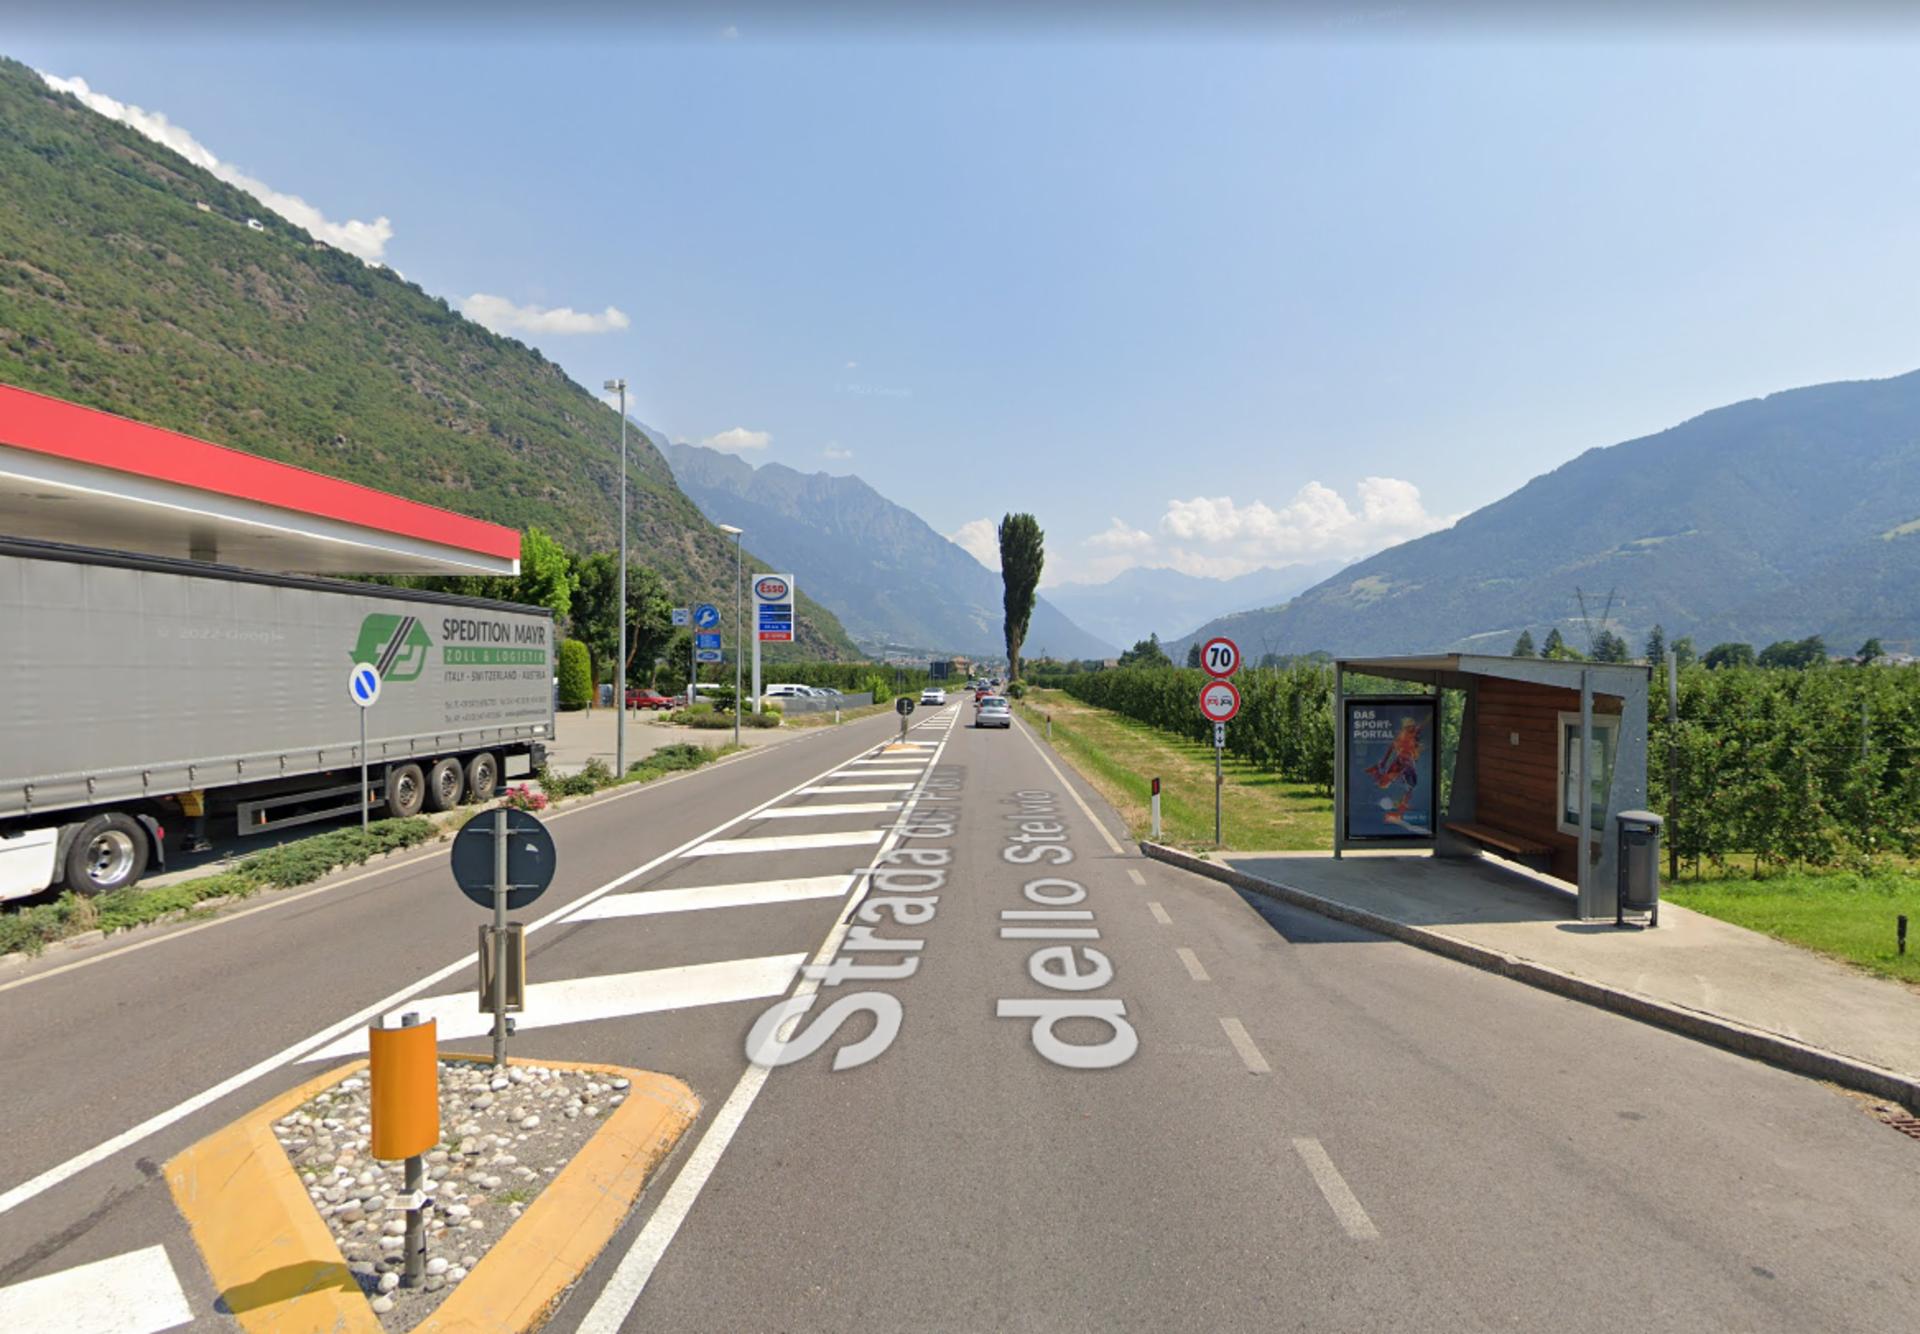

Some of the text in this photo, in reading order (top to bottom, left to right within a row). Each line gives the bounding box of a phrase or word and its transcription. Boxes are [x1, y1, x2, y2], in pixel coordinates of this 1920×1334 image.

[760, 583, 784, 593] Esso
[442, 618, 545, 645] SPEDITION MAYR
[446, 648, 476, 663] ZOLL
[496, 649, 545, 664] LOGISTIK
[1210, 647, 1231, 667] 70
[444, 670, 464, 682] ITALY
[471, 670, 517, 681] SWITZERLAND
[522, 670, 545, 681] AUSTRIA
[1353, 711, 1376, 720] DAS
[1353, 720, 1393, 729] SPORT-
[1353, 729, 1395, 739] PORTAL
